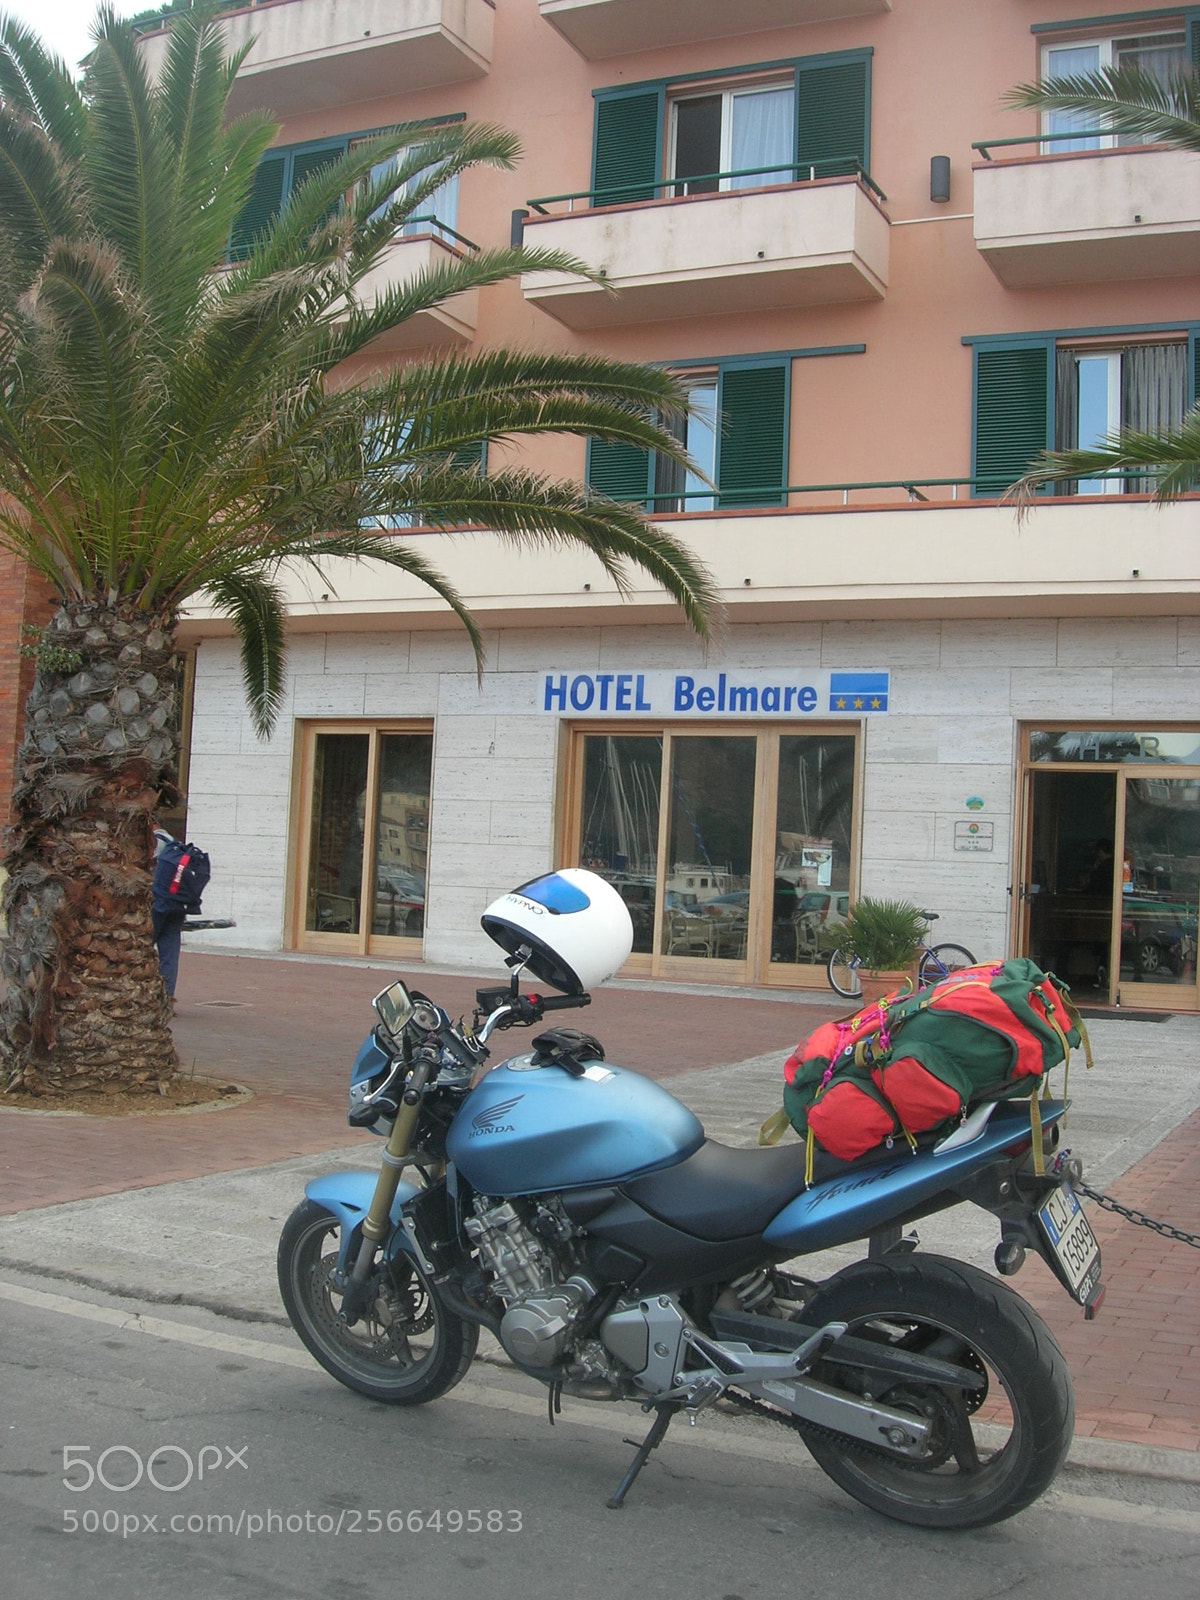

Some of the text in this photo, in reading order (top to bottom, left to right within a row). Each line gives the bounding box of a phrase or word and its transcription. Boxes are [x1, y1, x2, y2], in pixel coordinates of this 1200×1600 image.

[544, 673, 817, 712] HOTEL Belmare
[1079, 736, 1160, 760] H B
[468, 1125, 515, 1139] HONDA
[1048, 1194, 1068, 1232] CJ
[1062, 1219, 1094, 1278] 15899
